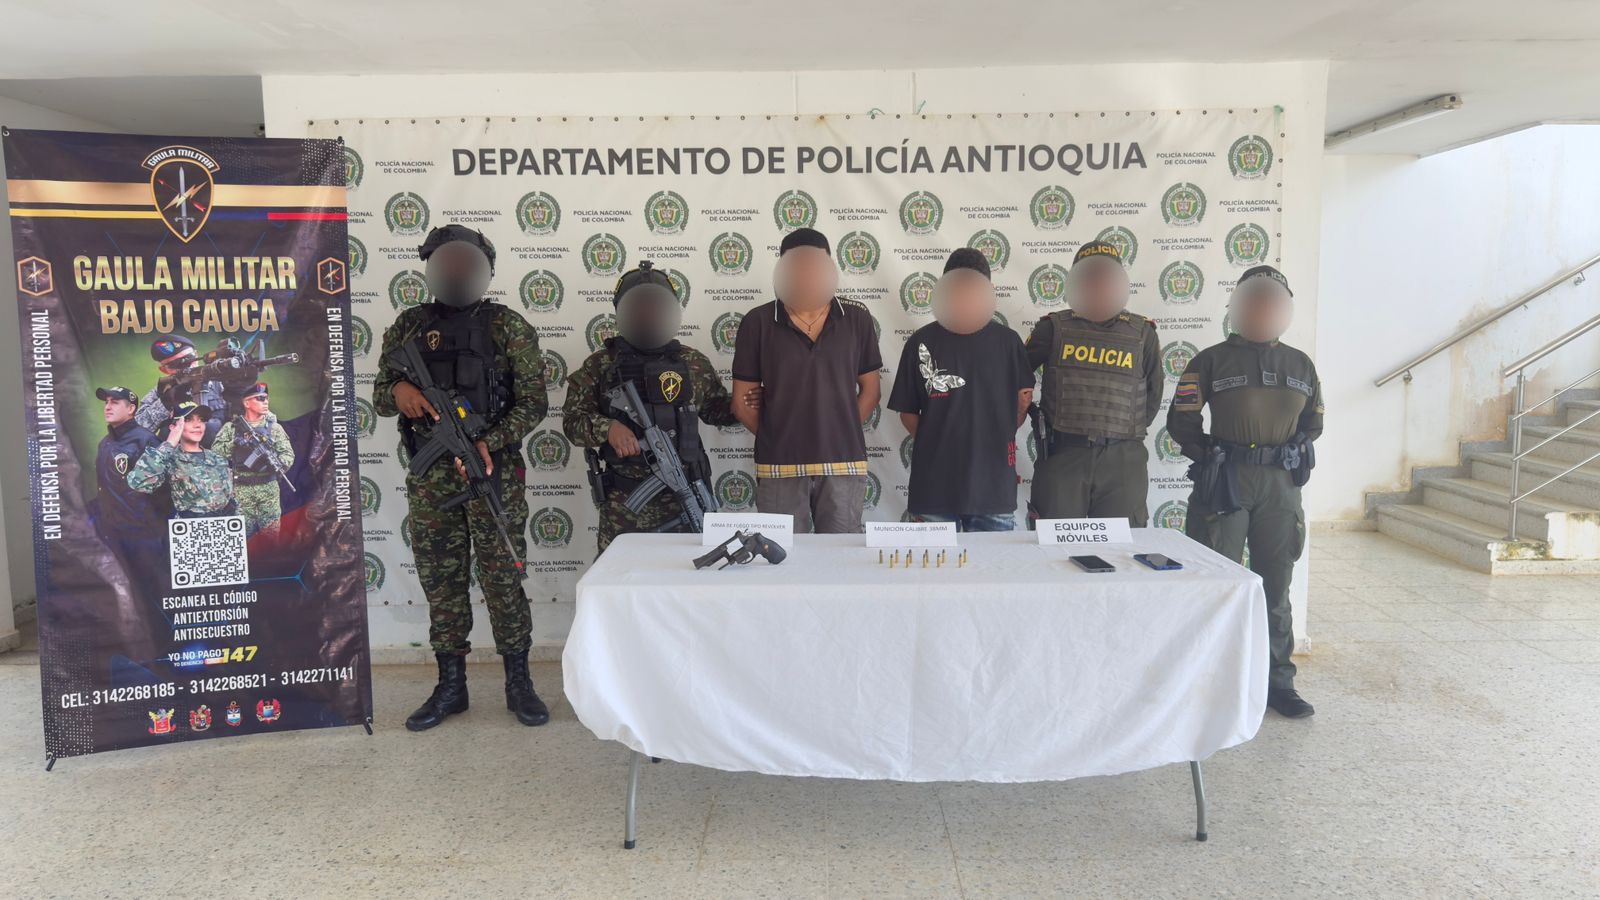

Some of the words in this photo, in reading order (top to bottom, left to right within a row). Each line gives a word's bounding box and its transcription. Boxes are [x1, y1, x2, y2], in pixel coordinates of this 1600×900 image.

[148, 150, 176, 166] GAULA
[178, 149, 215, 169] MILITAR
[452, 147, 730, 176] DEPARTAMENTO
[742, 147, 785, 174] DE
[797, 138, 934, 173] POLICÍA
[940, 142, 1147, 176] ANTIOQUIA
[73, 256, 174, 290] GAULA
[180, 256, 296, 290] MILITAR
[99, 299, 174, 334] BAJO
[183, 298, 279, 333] CAUCA
[327, 307, 341, 322] EN
[31, 309, 51, 367] PERSONAL
[328, 325, 344, 372] DEFENSA
[1062, 344, 1134, 369] POLICIA
[331, 376, 345, 396] POR
[36, 372, 55, 424] LIBERTAD
[332, 400, 346, 413] LA
[39, 430, 56, 442] LA
[332, 416, 349, 466] LIBERTAD
[41, 446, 57, 468] POR
[41, 472, 61, 522] DEFENSA
[335, 469, 352, 522] PERSONAL
[44, 526, 62, 540] EN
[1054, 522, 1106, 531] EQUIPOS
[1056, 532, 1108, 542] MÓVILES
[163, 595, 206, 610] ESCANEA
[210, 594, 220, 605] EL
[224, 590, 257, 605] CÓDIGO
[174, 606, 248, 625] ANTIEXTORSIÓN
[174, 624, 250, 641] ANTISECUESTRO
[168, 652, 180, 661] YO
[183, 651, 195, 660] NO
[198, 649, 222, 659] PAGO
[222, 646, 258, 664] 147
[61, 693, 90, 709] CEL:
[92, 683, 175, 705] 3142268185
[190, 675, 267, 694] 3142268521
[281, 666, 354, 686] 3142271141
